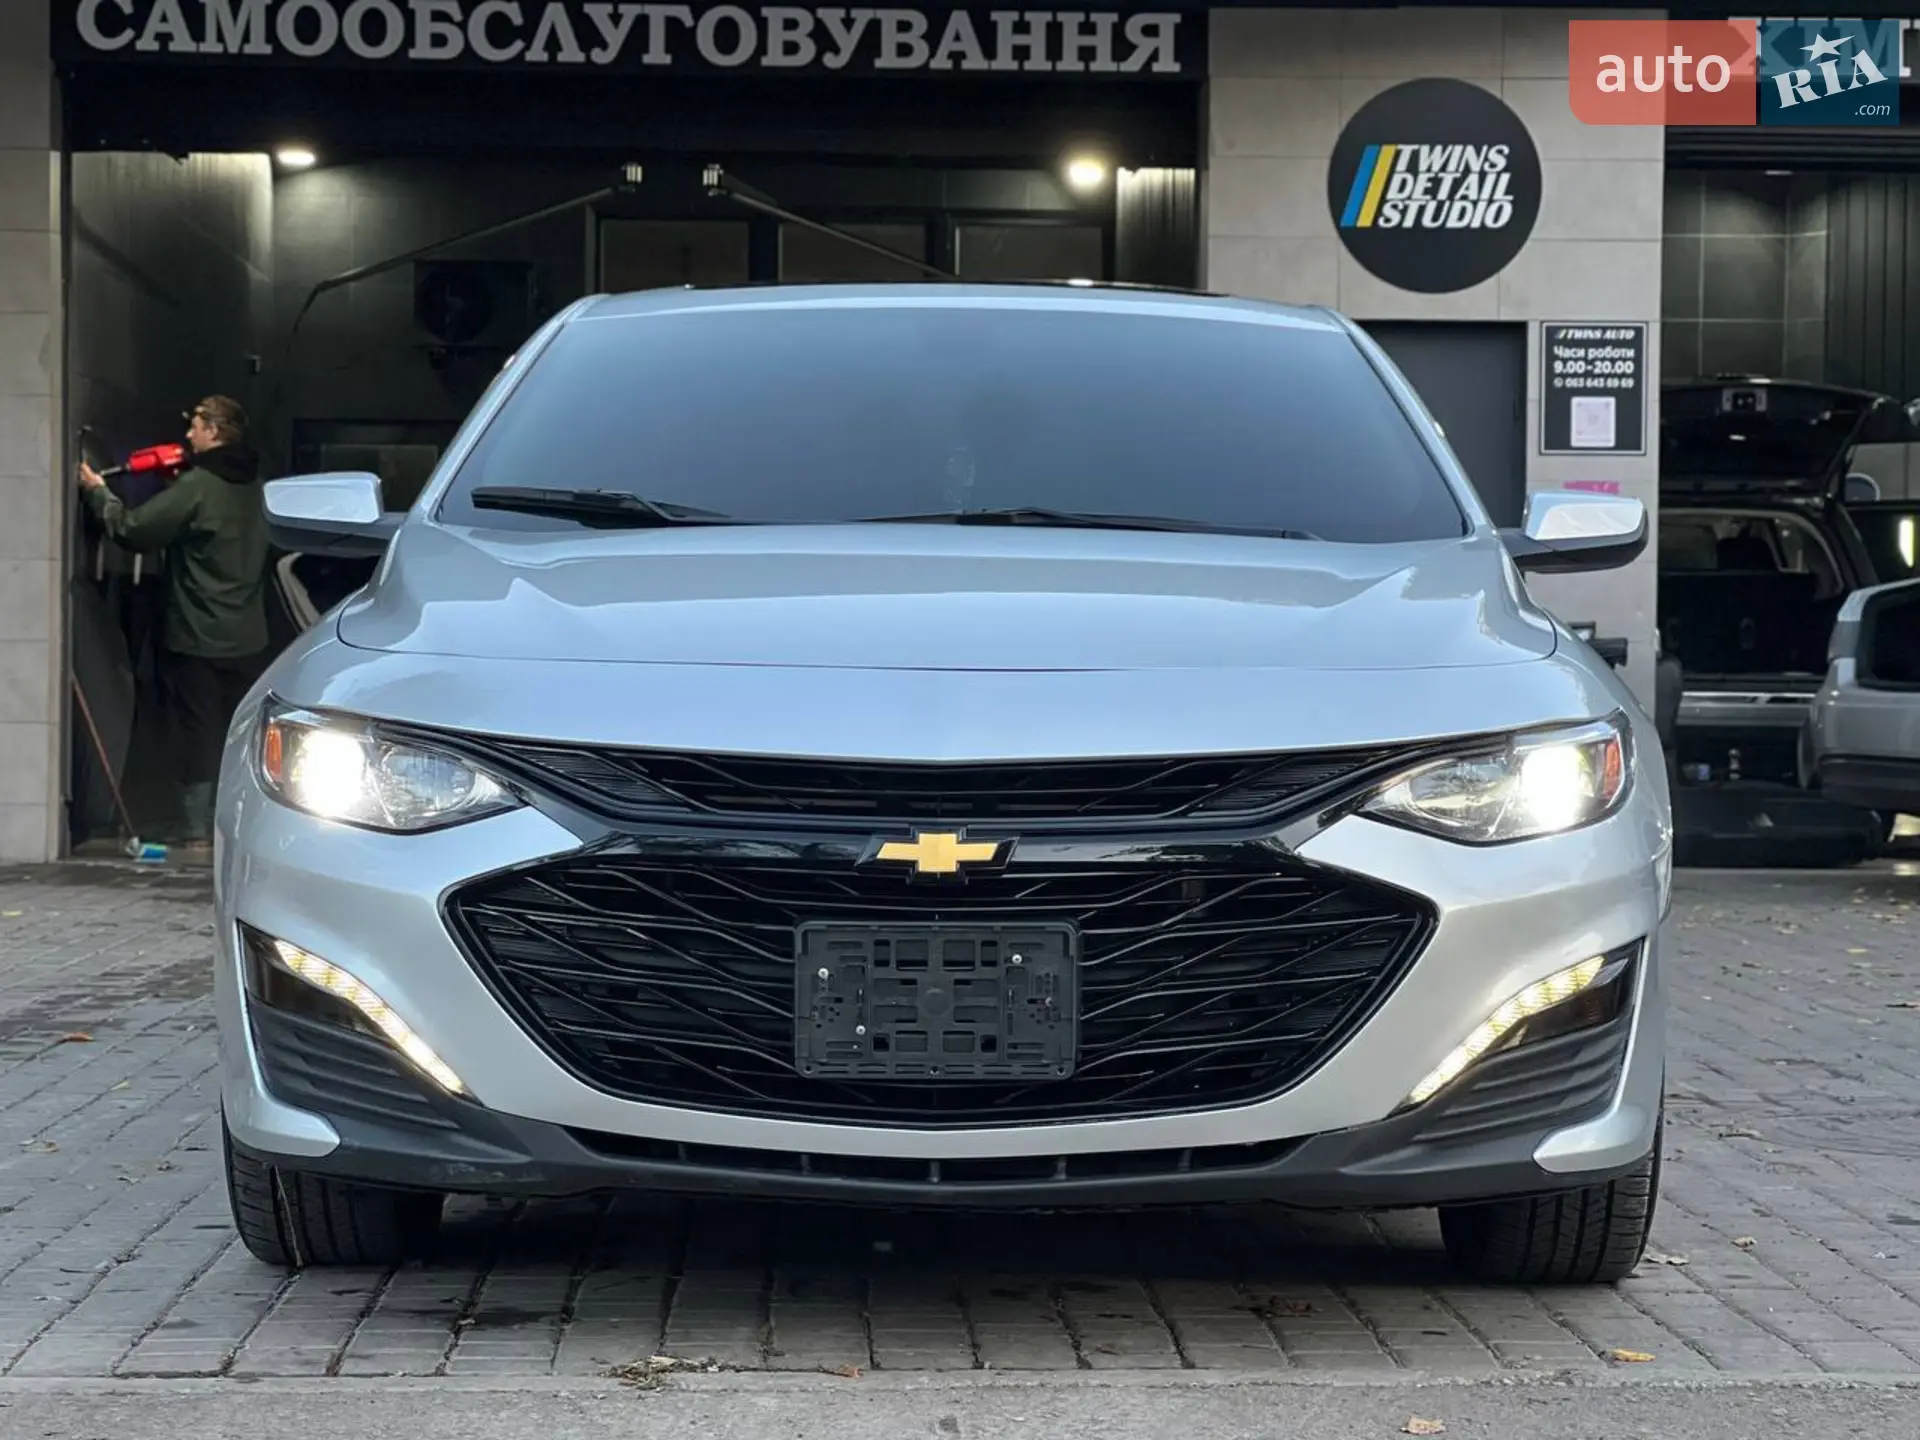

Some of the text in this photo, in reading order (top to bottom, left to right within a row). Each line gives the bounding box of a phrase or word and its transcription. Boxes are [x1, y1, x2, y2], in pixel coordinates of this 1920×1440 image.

[76, 0, 1182, 73] САМООБСЛУГОВУВАННЯ
[1394, 144, 1510, 172] TWINS
[1385, 172, 1514, 201] DETAIL
[1377, 200, 1514, 229] STUDIO
[1566, 328, 1636, 340] TWINS AUTO
[1553, 345, 1636, 361] Часи роботи
